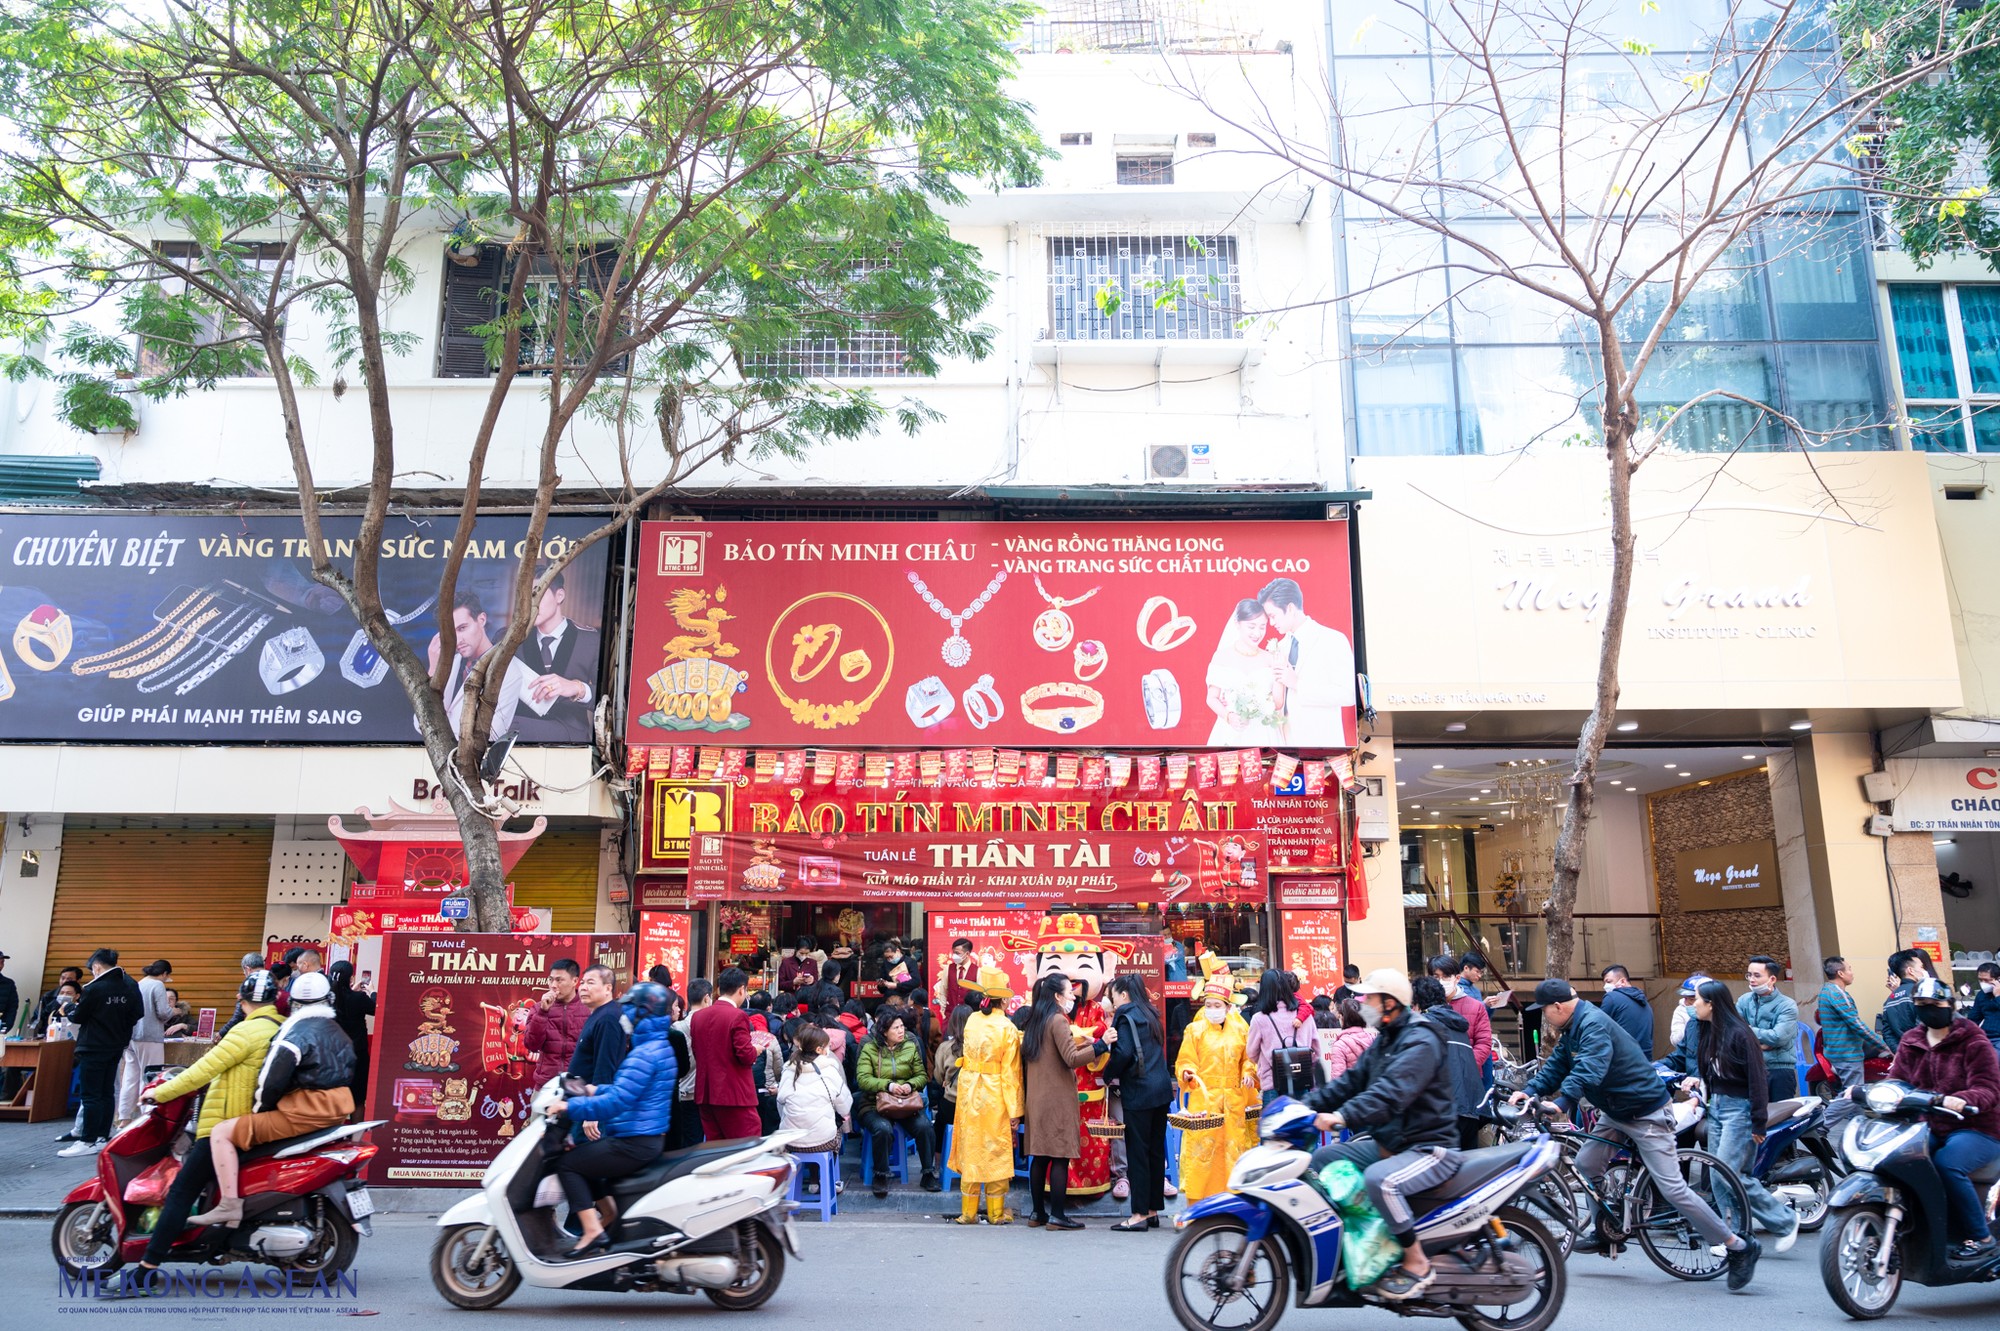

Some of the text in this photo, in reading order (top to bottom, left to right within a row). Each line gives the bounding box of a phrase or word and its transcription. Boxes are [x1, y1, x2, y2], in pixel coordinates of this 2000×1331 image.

[198, 533, 274, 558] VÀNG
[281, 538, 358, 559] TRN
[381, 534, 436, 560] SỨC
[1004, 533, 1224, 552] VÀNG RỒNG THĂNG LONG
[12, 529, 186, 575] CHUYÊN BIỆT
[723, 539, 976, 562] BẢO TÍN MINH CHÂU
[1004, 553, 1310, 576] VÀNG TRANG SỨC CHẤT LƯỢNG CAO
[1496, 573, 1815, 622] Meg Grand
[1648, 626, 1817, 640] INSTITUTE CLINIC
[77, 704, 363, 727] GIÚP PHÁI MẠNH THÊM SANG
[750, 788, 1237, 832] BẢO TÍN MINH CHÂU
[1252, 798, 1328, 808] TRẦN NHÂN TÔNG
[1257, 815, 1266, 824] LÀ
[1282, 815, 1304, 824] HÀNG
[1304, 816, 1324, 824] VÀNG
[1926, 820, 1935, 828] 37
[1937, 818, 1958, 828] TRẦN
[1961, 819, 1982, 828] NHÂN
[1284, 826, 1299, 835] CỦA
[1301, 827, 1321, 835] BTMC
[1324, 827, 1332, 835] VÀ
[1267, 836, 1287, 845] TRẦN
[1288, 837, 1310, 845] NHÂN
[863, 838, 1111, 868] TUẦN LỄ THẦN TÀI
[1273, 847, 1290, 856] NĂM
[865, 871, 1115, 888] KIM MÃO THẦN TÀI KHAI XUÂN ĐẠI PHÁT
[1693, 863, 1759, 885] Mega Grand
[981, 890, 993, 898] ĐẾN
[994, 890, 1006, 898] HẾT
[1050, 891, 1064, 899] LỊCH
[969, 915, 991, 926] THẦN
[992, 917, 1005, 926] TÀI
[431, 939, 465, 948] TUẦN LỄ
[428, 947, 545, 972] THẦN TÀI
[410, 973, 550, 987] KIM MÃO THẦN TÀI KHAI XUÂN ĐẠI PHÁ
[486, 1053, 505, 1063] CHÂU
[422, 1128, 434, 1136] vàng
[479, 1138, 492, 1146] hạnh
[492, 1138, 505, 1146] phúc
[281, 1160, 317, 1169] LEAD
